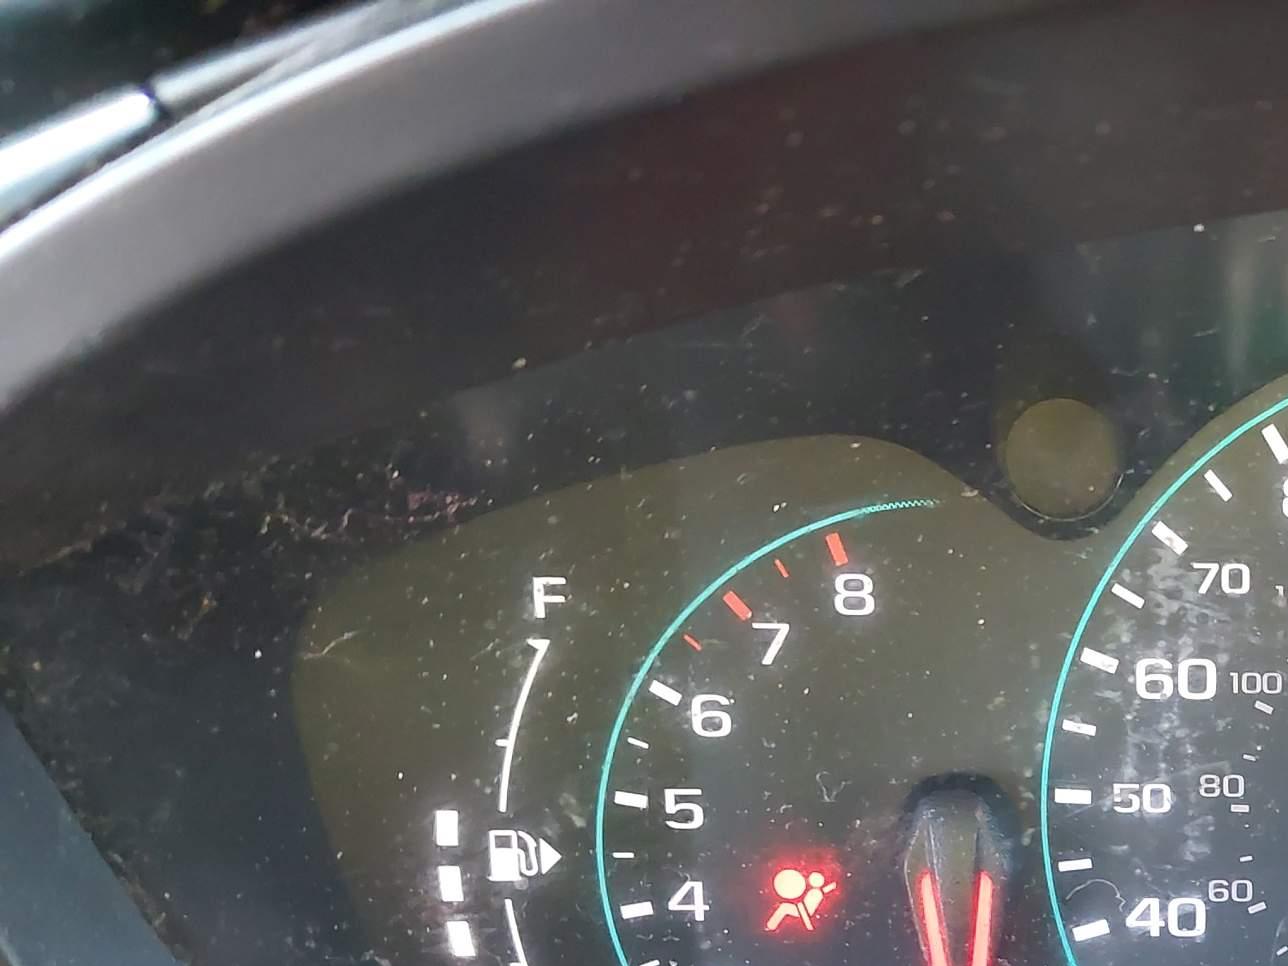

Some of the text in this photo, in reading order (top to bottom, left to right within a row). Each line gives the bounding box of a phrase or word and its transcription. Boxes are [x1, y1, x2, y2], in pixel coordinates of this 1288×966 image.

[532, 575, 568, 620] F
[833, 573, 876, 617] 8
[1192, 561, 1251, 595] 70
[751, 622, 790, 665] 7
[1134, 658, 1218, 701] 60
[1229, 670, 1283, 695] 100
[690, 694, 732, 737] 6
[1112, 783, 1173, 815] 50
[1198, 774, 1245, 798] 80
[662, 788, 704, 830] 5
[666, 880, 709, 922] 4
[1207, 880, 1254, 903] 60
[1125, 897, 1207, 937] 40
